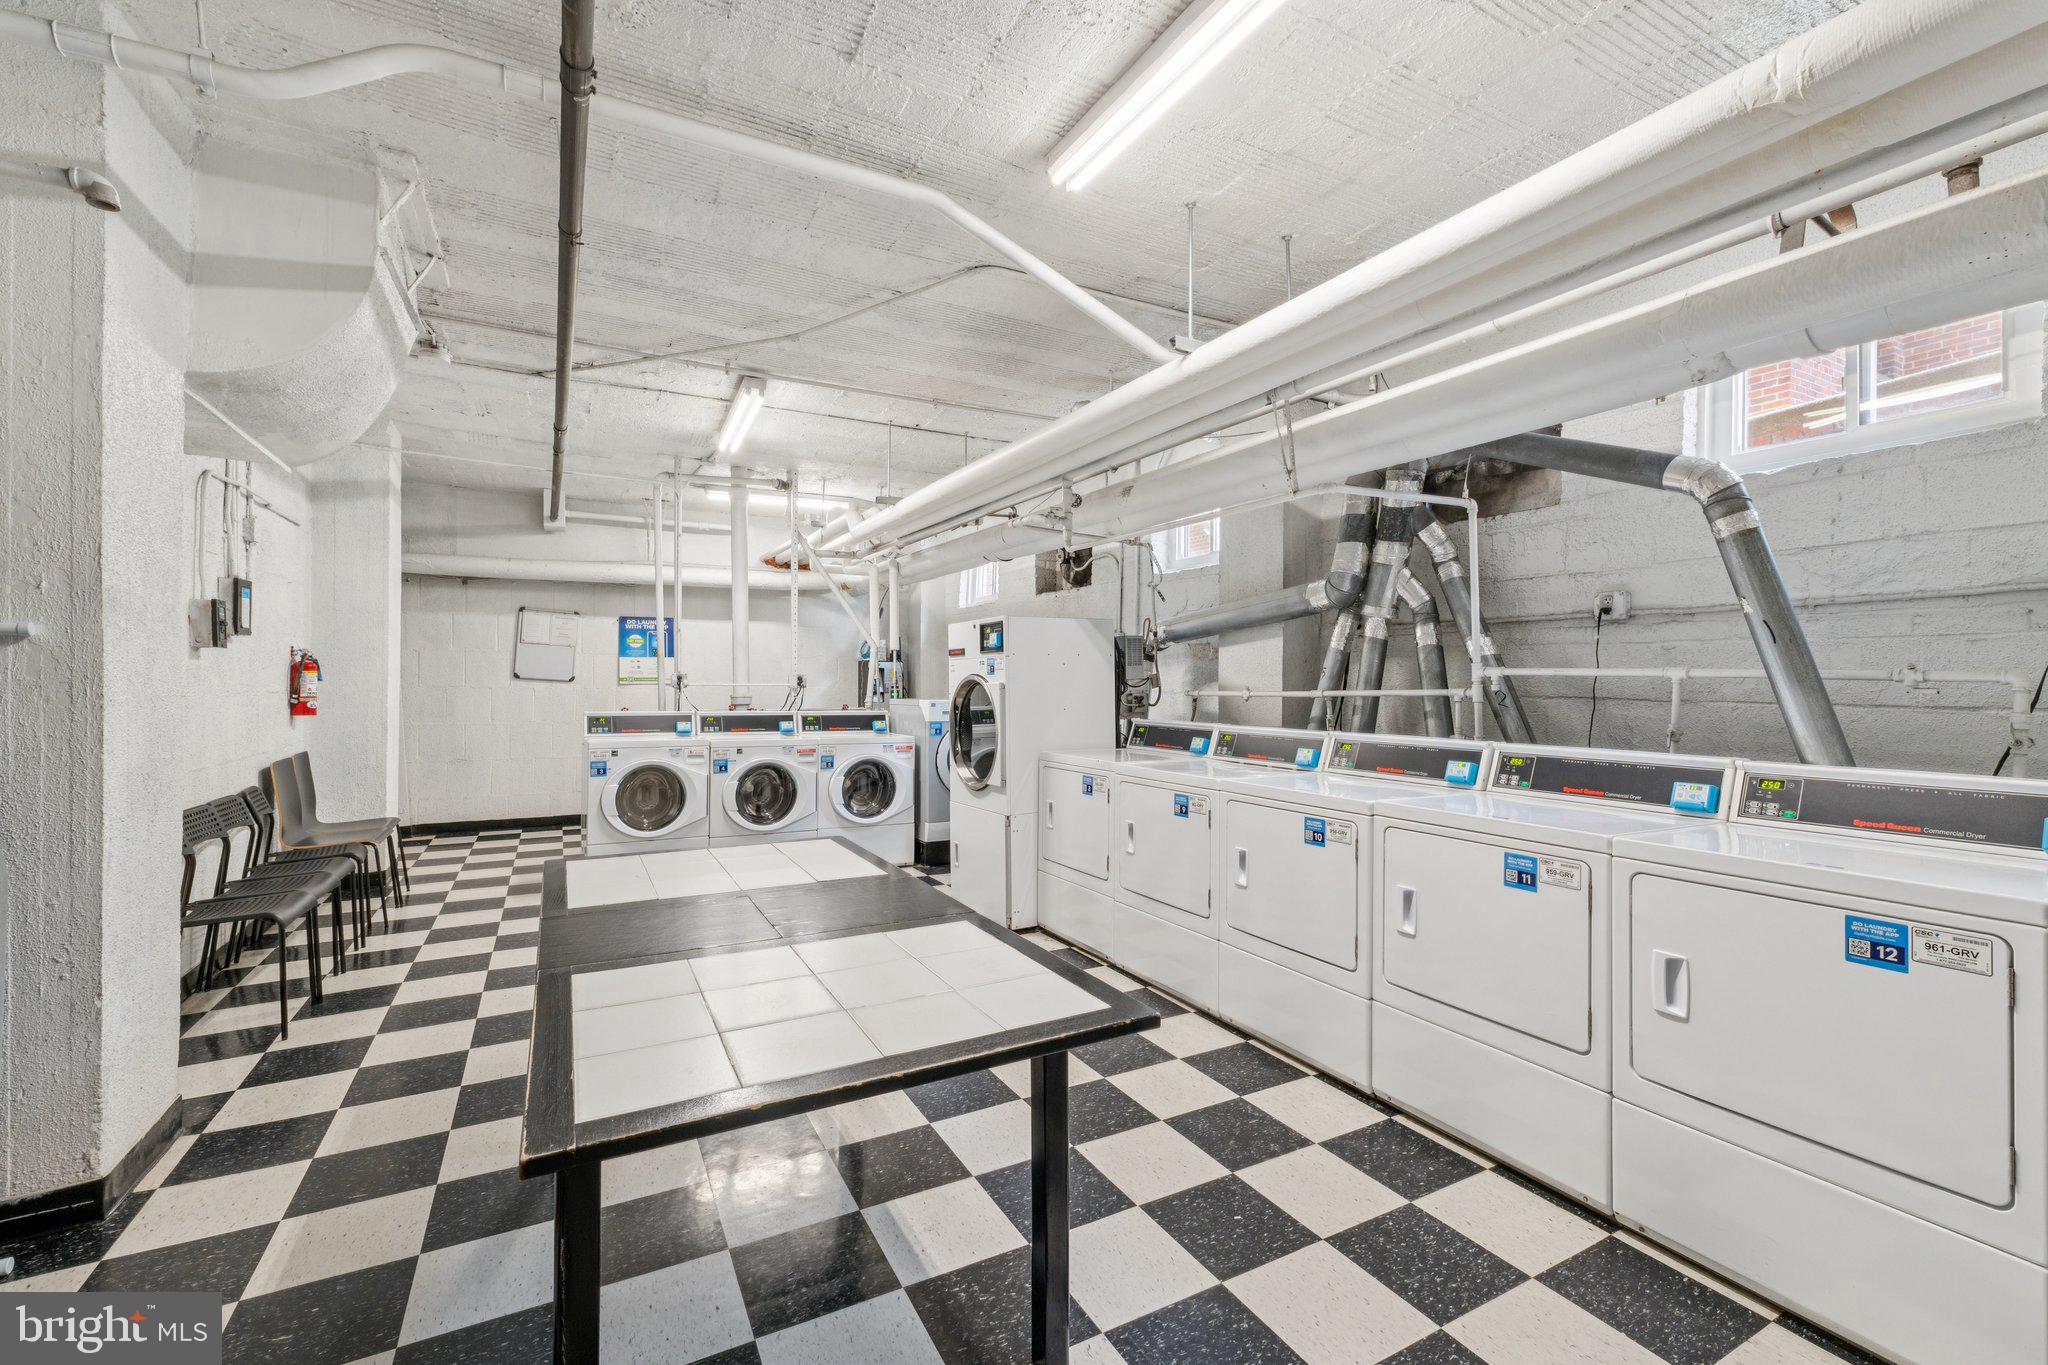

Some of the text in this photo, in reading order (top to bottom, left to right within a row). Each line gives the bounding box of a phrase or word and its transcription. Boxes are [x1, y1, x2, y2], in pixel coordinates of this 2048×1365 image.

[1494, 690, 1511, 708] 2
[1761, 780, 1781, 789] 250
[1853, 818, 1987, 841] Speed Queen Commercial Dryer
[1313, 832, 1323, 842] 10
[1521, 873, 1531, 884] 11
[1545, 868, 1575, 879] 959-GRV
[1850, 925, 1870, 934] WITH
[1870, 928, 1885, 936] THE
[1885, 930, 1900, 938] APP
[1864, 922, 1898, 933] LAUNDRY
[1914, 929, 1934, 937] CSC
[1876, 945, 1898, 962] 12
[1924, 942, 1980, 960] 961-GRV
